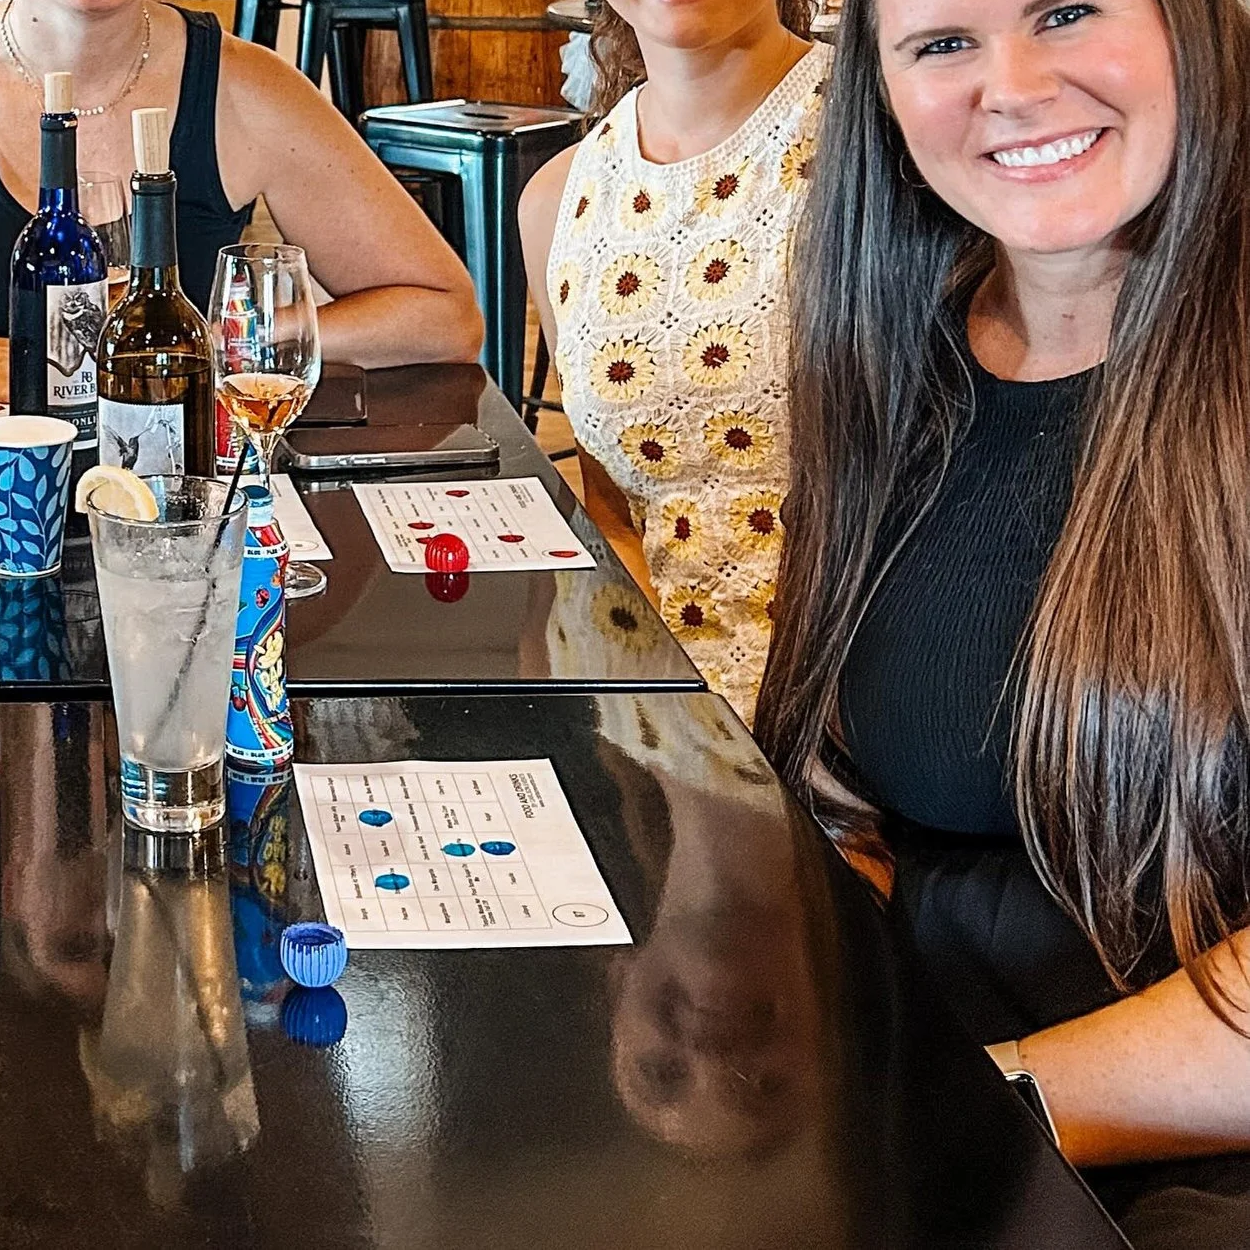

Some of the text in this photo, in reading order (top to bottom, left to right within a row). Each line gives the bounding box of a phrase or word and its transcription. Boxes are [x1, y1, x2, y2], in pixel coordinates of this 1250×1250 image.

[53, 383, 88, 399] RIVER
[509, 774, 534, 818] FOOD AND DRINKS
